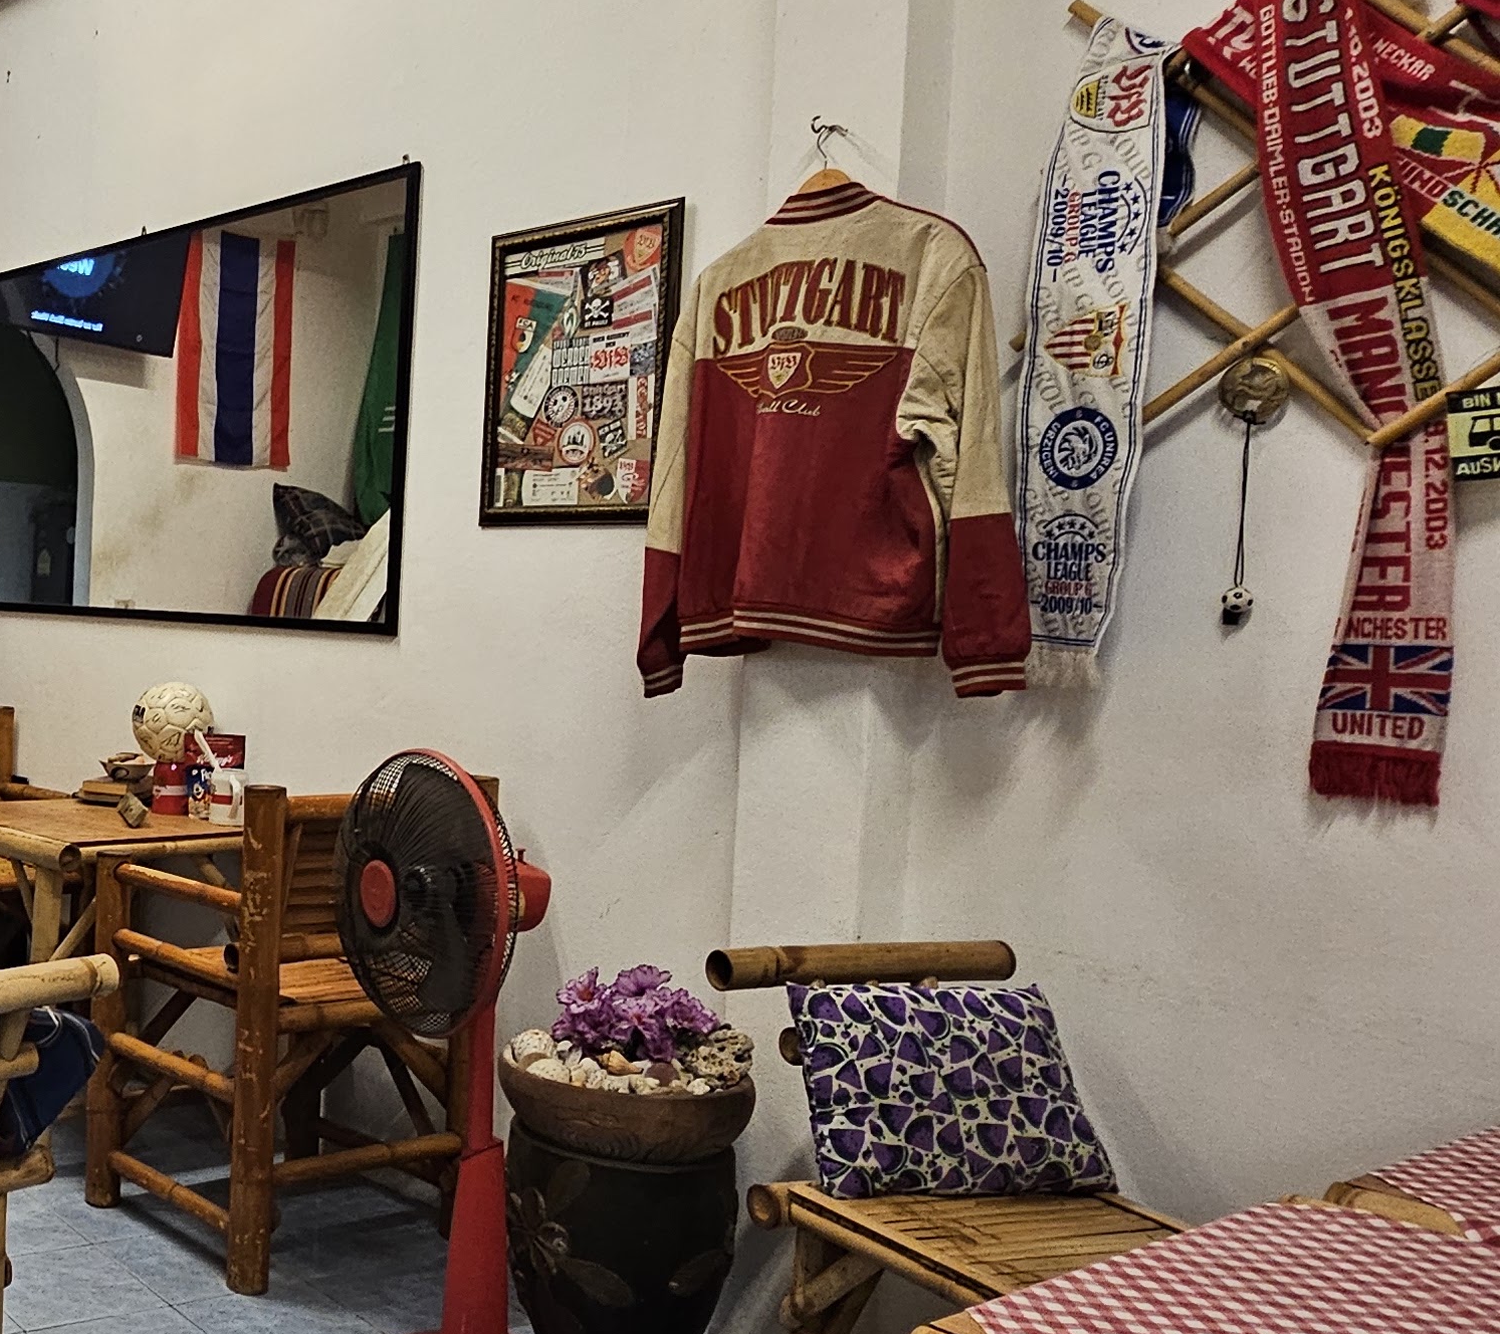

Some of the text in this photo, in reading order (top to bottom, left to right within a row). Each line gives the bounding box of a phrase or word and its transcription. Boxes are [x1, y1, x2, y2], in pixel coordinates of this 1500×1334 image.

[1078, 192, 1097, 259] LEAGUE
[1096, 170, 1122, 274] CHAMPS
[1462, 392, 1491, 409] BIN
[1031, 540, 1107, 564] CHAMPS
[1046, 562, 1093, 582] LEAGUE
[1331, 711, 1426, 741] UNITED
